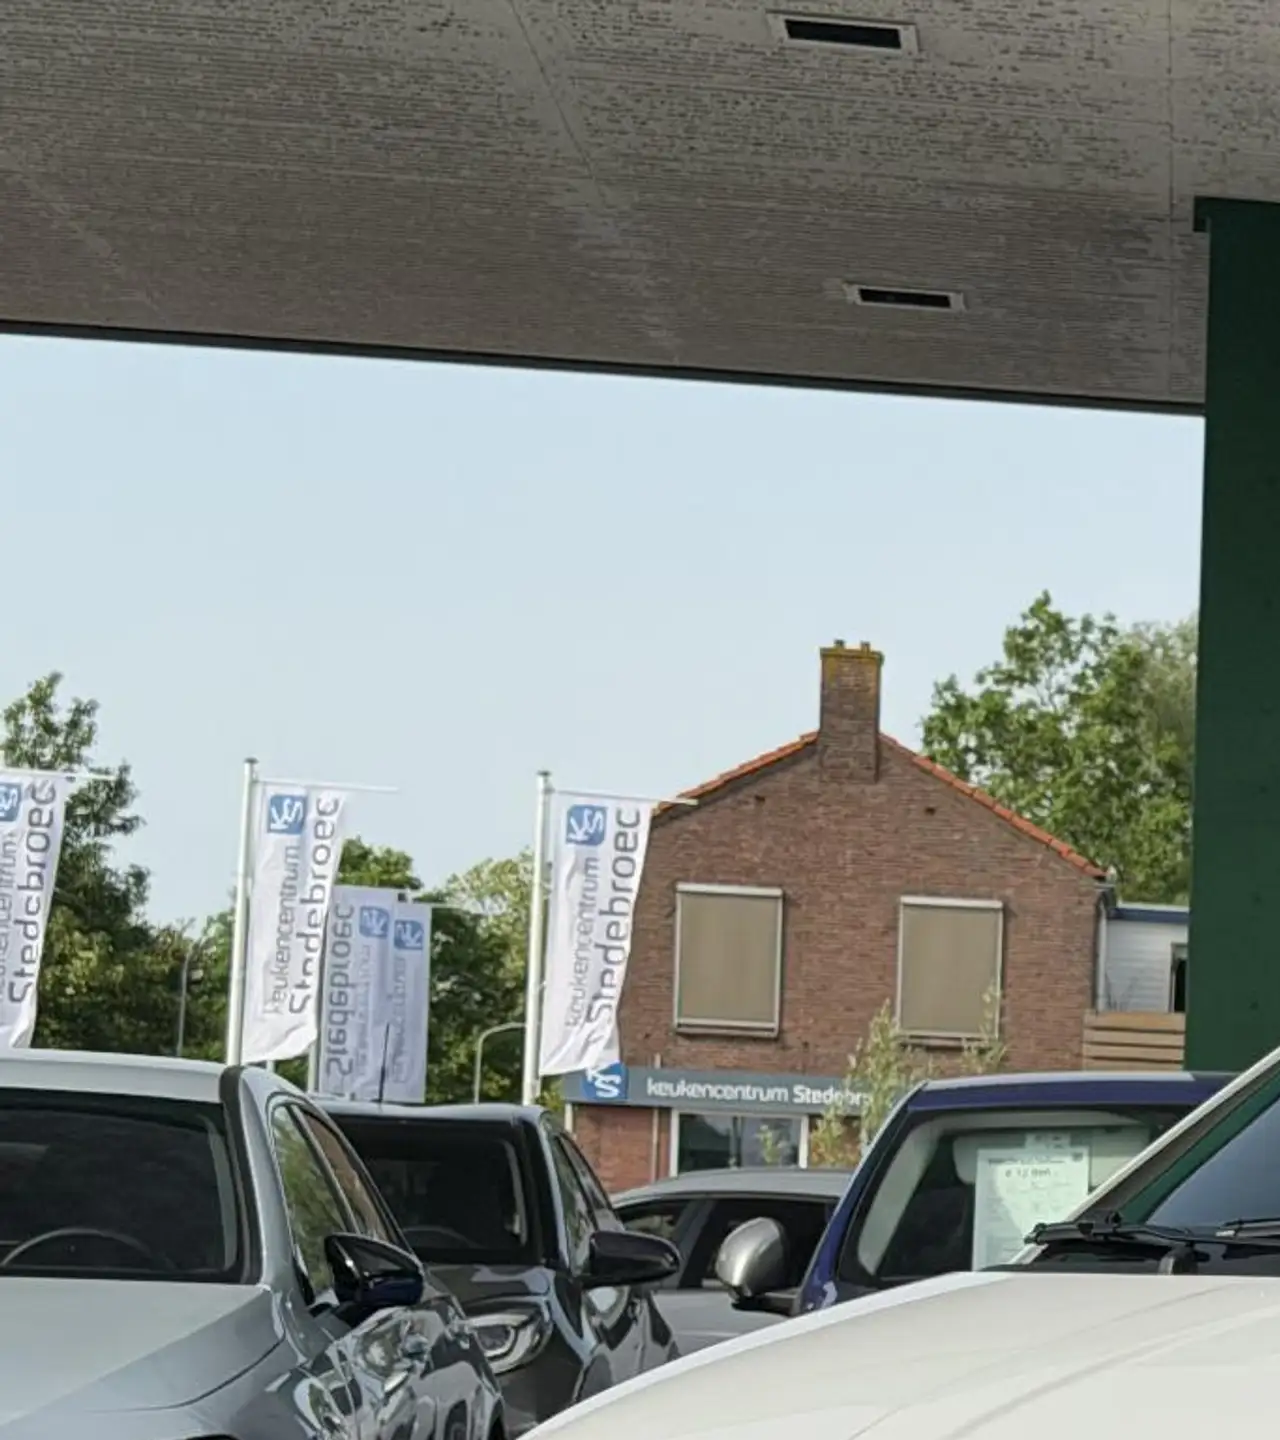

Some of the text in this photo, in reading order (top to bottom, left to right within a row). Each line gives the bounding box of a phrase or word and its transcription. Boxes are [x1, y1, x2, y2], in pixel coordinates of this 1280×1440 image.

[270, 799, 304, 831] KS
[568, 809, 604, 842] KS
[647, 1077, 788, 1102] keukencentrum
